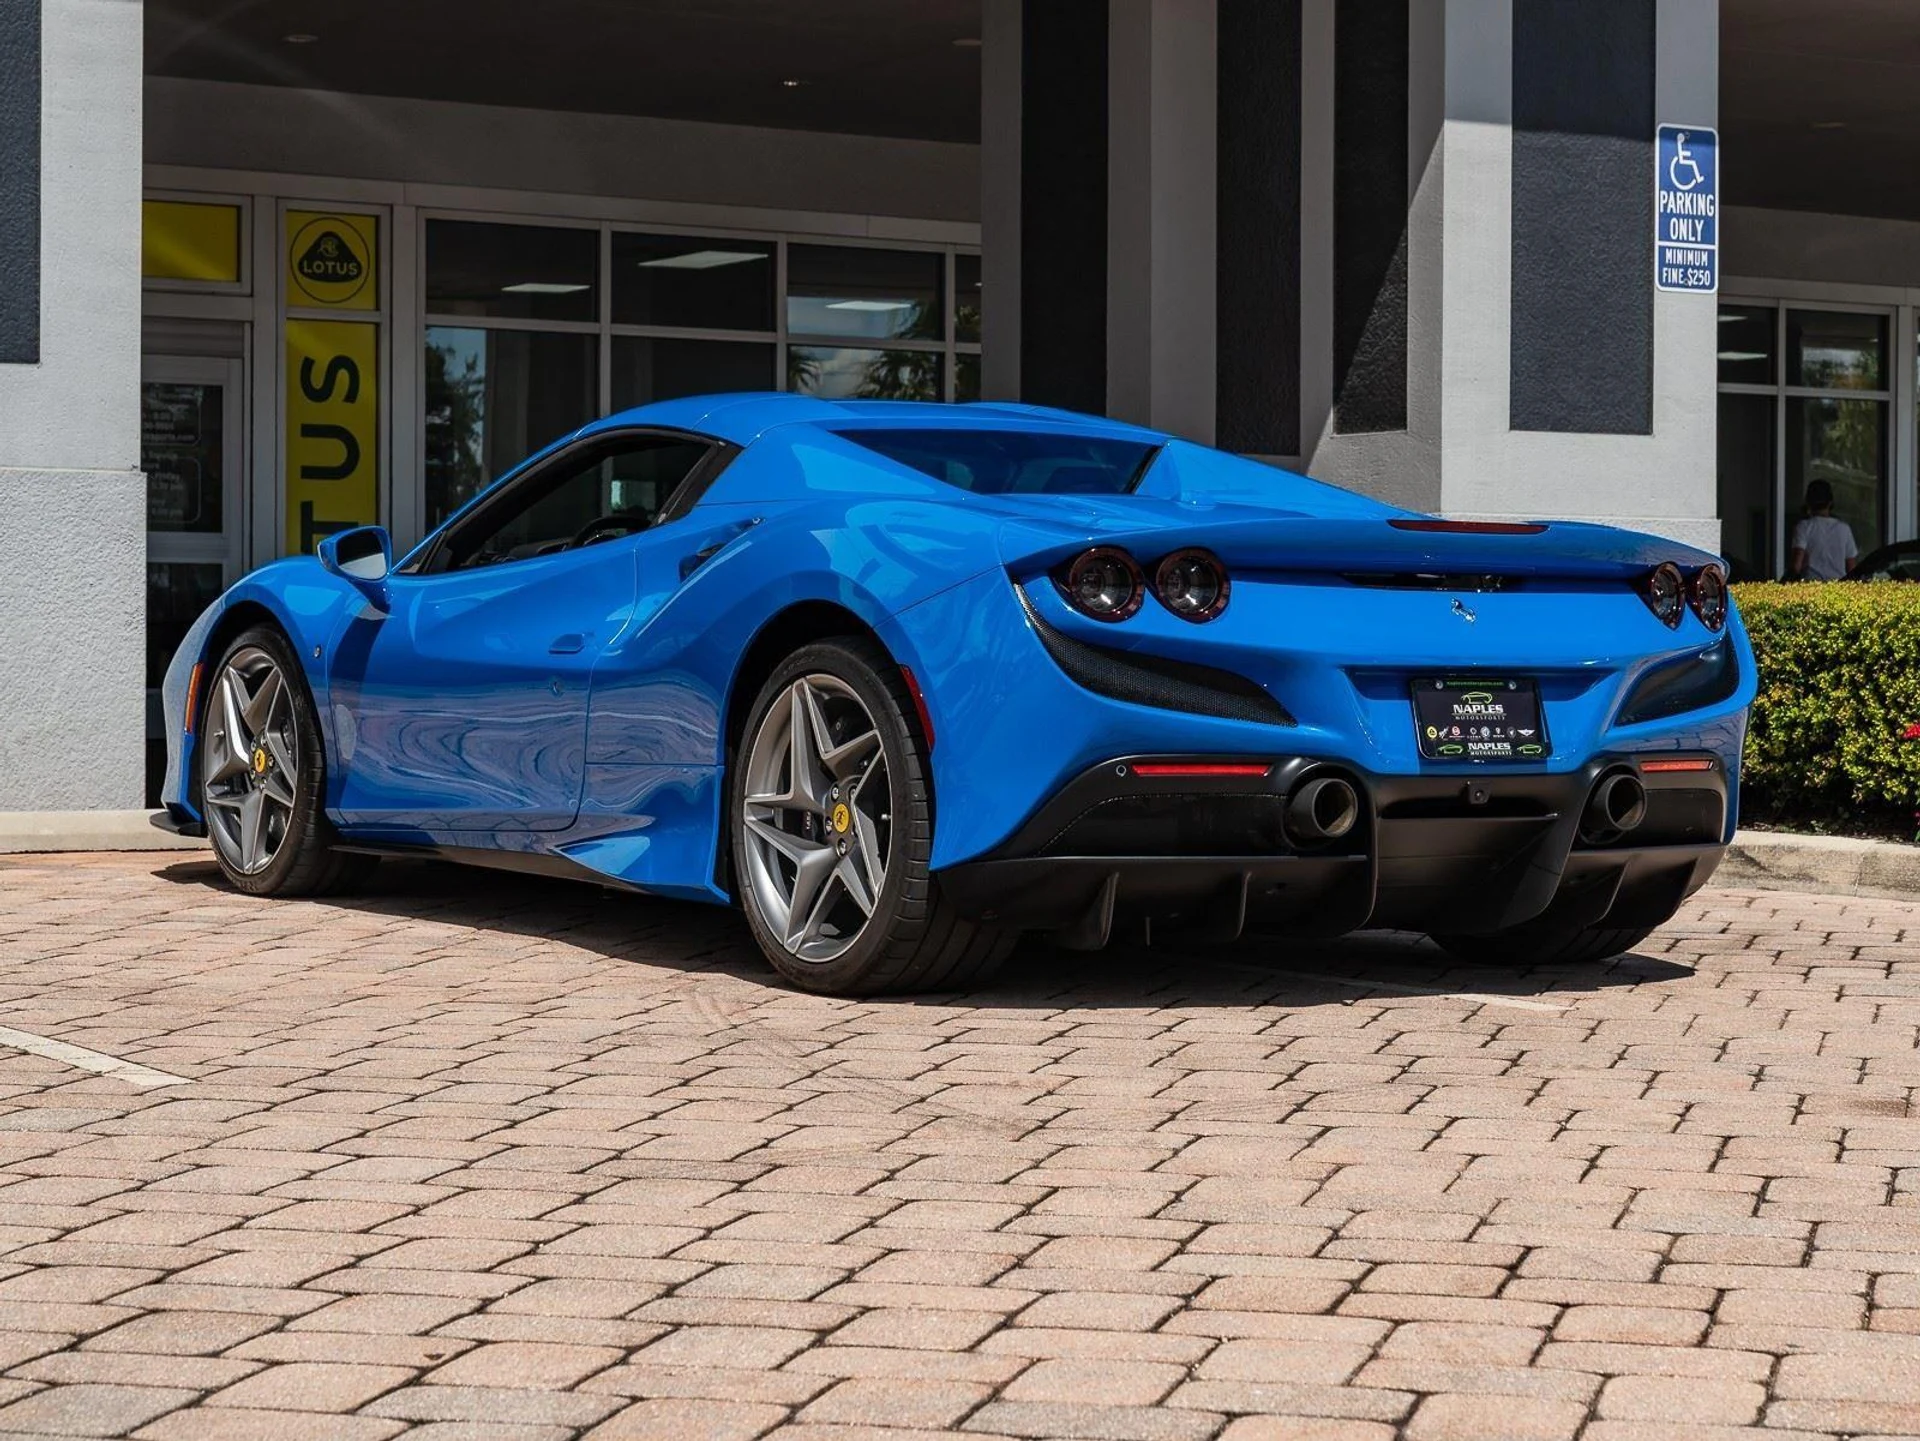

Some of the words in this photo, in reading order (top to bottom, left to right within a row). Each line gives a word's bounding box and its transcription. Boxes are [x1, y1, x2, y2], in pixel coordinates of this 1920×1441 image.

[1660, 190, 1714, 216] PARKING
[1669, 217, 1704, 241] ONLY
[1665, 248, 1708, 266] MINIMUM
[303, 260, 358, 275] LOTUS
[1662, 267, 1684, 284] FINE
[1687, 268, 1711, 286] $250
[1453, 704, 1504, 713] NAPLES
[1468, 742, 1511, 750] NAPLES
